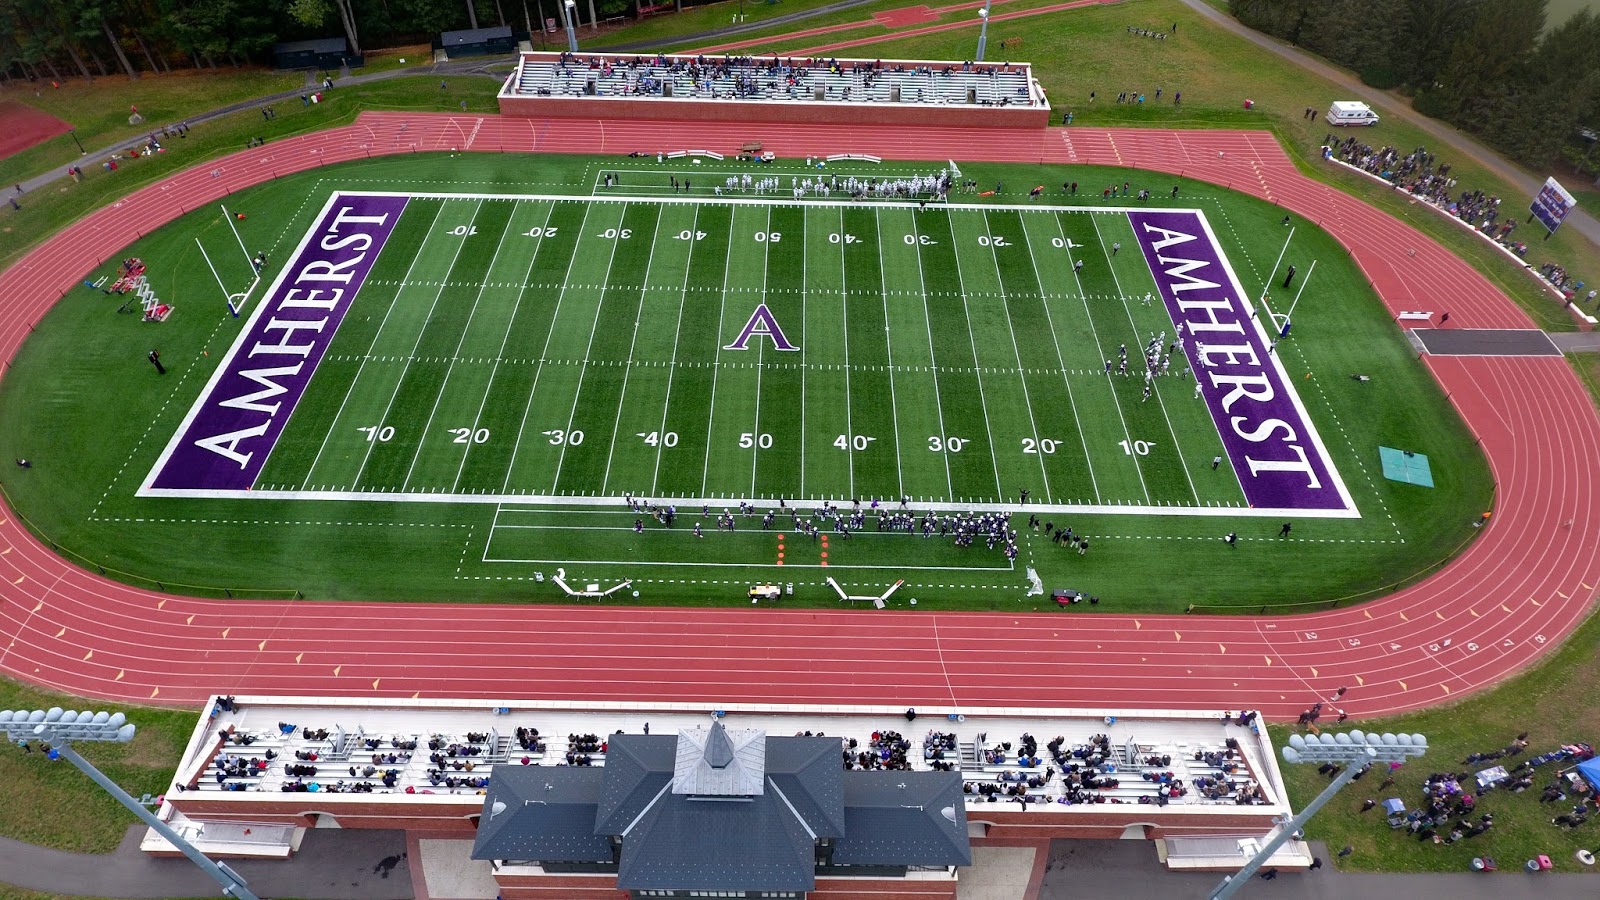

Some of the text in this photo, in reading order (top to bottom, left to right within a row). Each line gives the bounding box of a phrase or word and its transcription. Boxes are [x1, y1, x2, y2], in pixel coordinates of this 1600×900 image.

[453, 225, 478, 236] 10
[529, 226, 558, 237] 20
[604, 228, 633, 239] 30
[679, 230, 708, 241] 40
[754, 231, 782, 243] 50
[828, 233, 857, 244] 40
[904, 234, 932, 246] 30
[977, 236, 1007, 247] 20
[1051, 237, 1077, 248] 10
[722, 303, 801, 351] A
[194, 206, 389, 470] AMHERST
[1143, 222, 1322, 489] AMHERST
[365, 425, 396, 442] 10
[452, 428, 490, 444] 20
[548, 429, 585, 446] 30
[643, 431, 679, 447] 40
[738, 432, 773, 449] 50
[833, 434, 868, 450] 40
[927, 436, 963, 452] 30
[1021, 438, 1057, 454] 20
[1118, 439, 1150, 456] 10
[1304, 631, 1318, 640] 2
[1349, 638, 1361, 647] 3
[1390, 642, 1402, 651] 4
[1429, 643, 1442, 652] 5
[1467, 642, 1480, 652] 6
[1503, 638, 1515, 647] 7
[1535, 634, 1547, 644] 8
